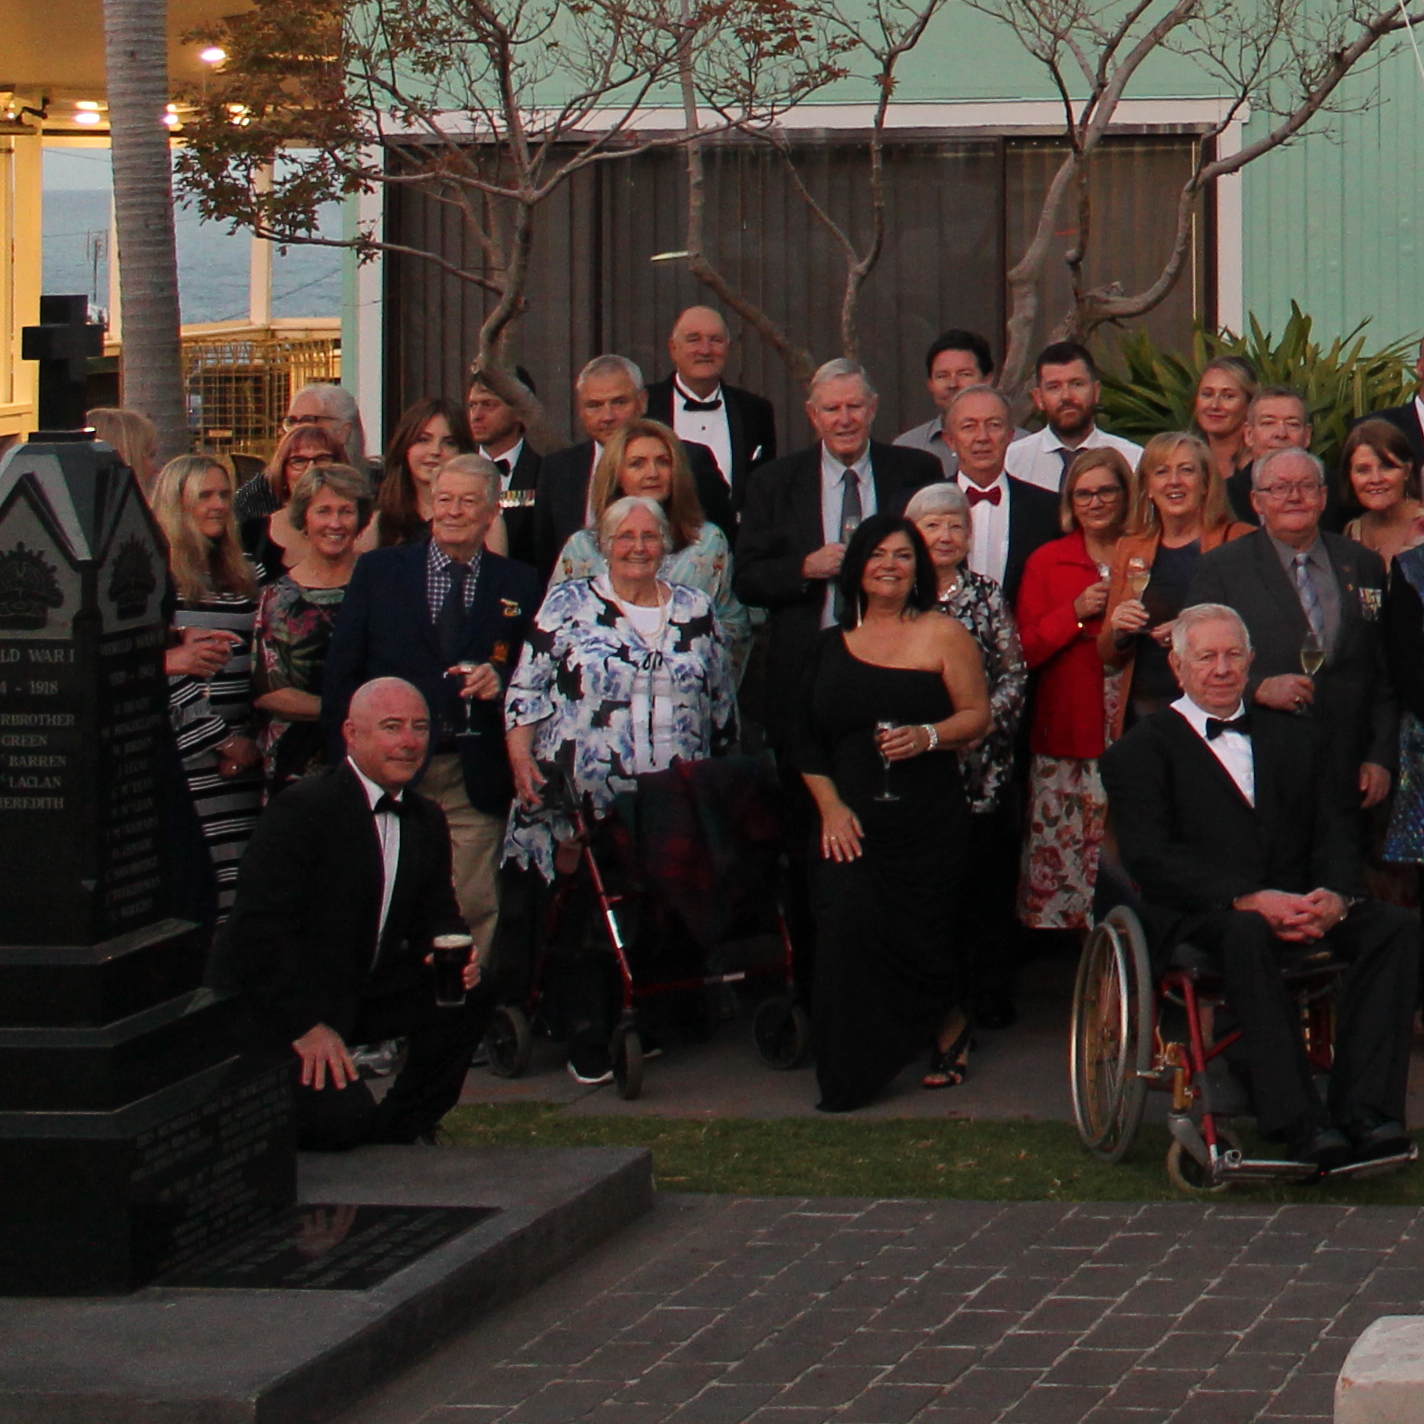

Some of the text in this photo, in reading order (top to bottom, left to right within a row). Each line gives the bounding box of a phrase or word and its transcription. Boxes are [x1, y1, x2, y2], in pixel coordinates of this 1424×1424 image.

[28, 648, 66, 663] WAR
[30, 680, 59, 695] 1918
[1, 734, 48, 747] GREEN
[0, 796, 65, 809] EREDITH
